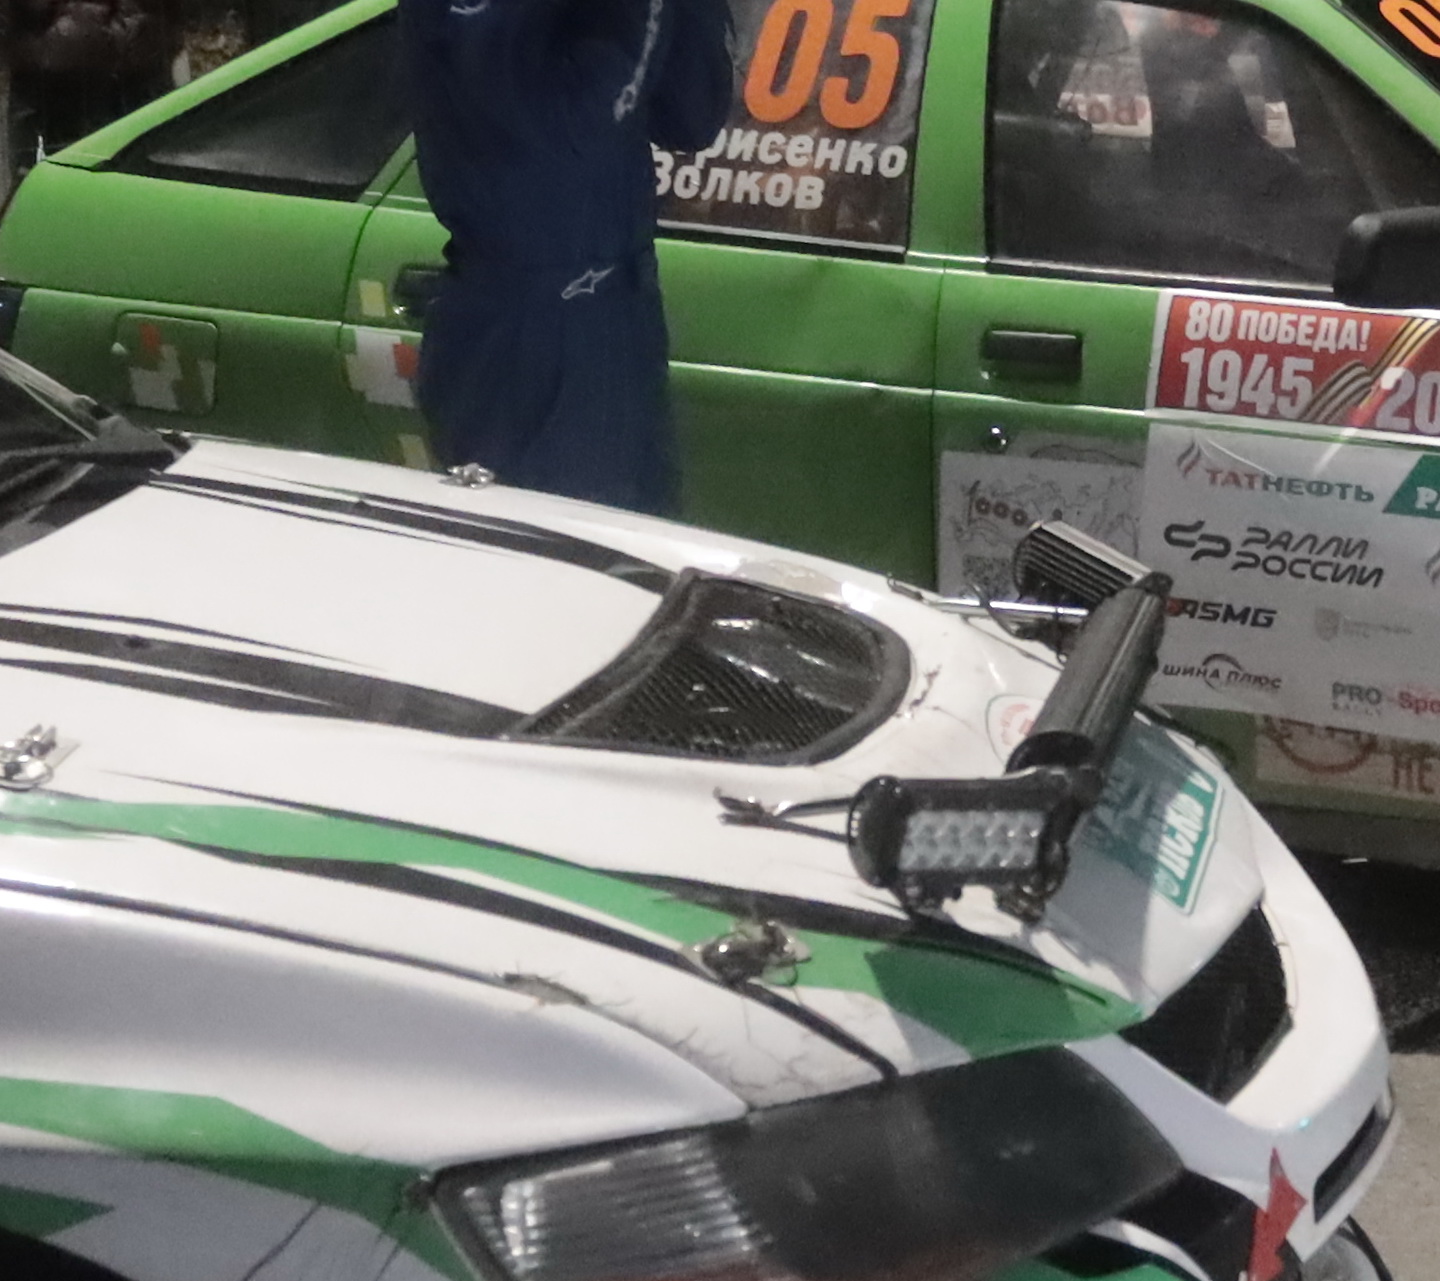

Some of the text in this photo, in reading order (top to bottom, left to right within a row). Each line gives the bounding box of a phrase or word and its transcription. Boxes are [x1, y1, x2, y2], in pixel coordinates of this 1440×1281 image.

[1185, 300, 1371, 354] 80 ПОБЕДА!
[1180, 346, 1316, 420] 1945
[1205, 468, 1375, 503] ТАТНЕФТЬ
[1240, 526, 1370, 560] РАЛЛИ
[1231, 554, 1385, 589] РОССИИ
[1162, 663, 1283, 689] ШИНА ПЛЮС
[1331, 681, 1382, 706] PRO
